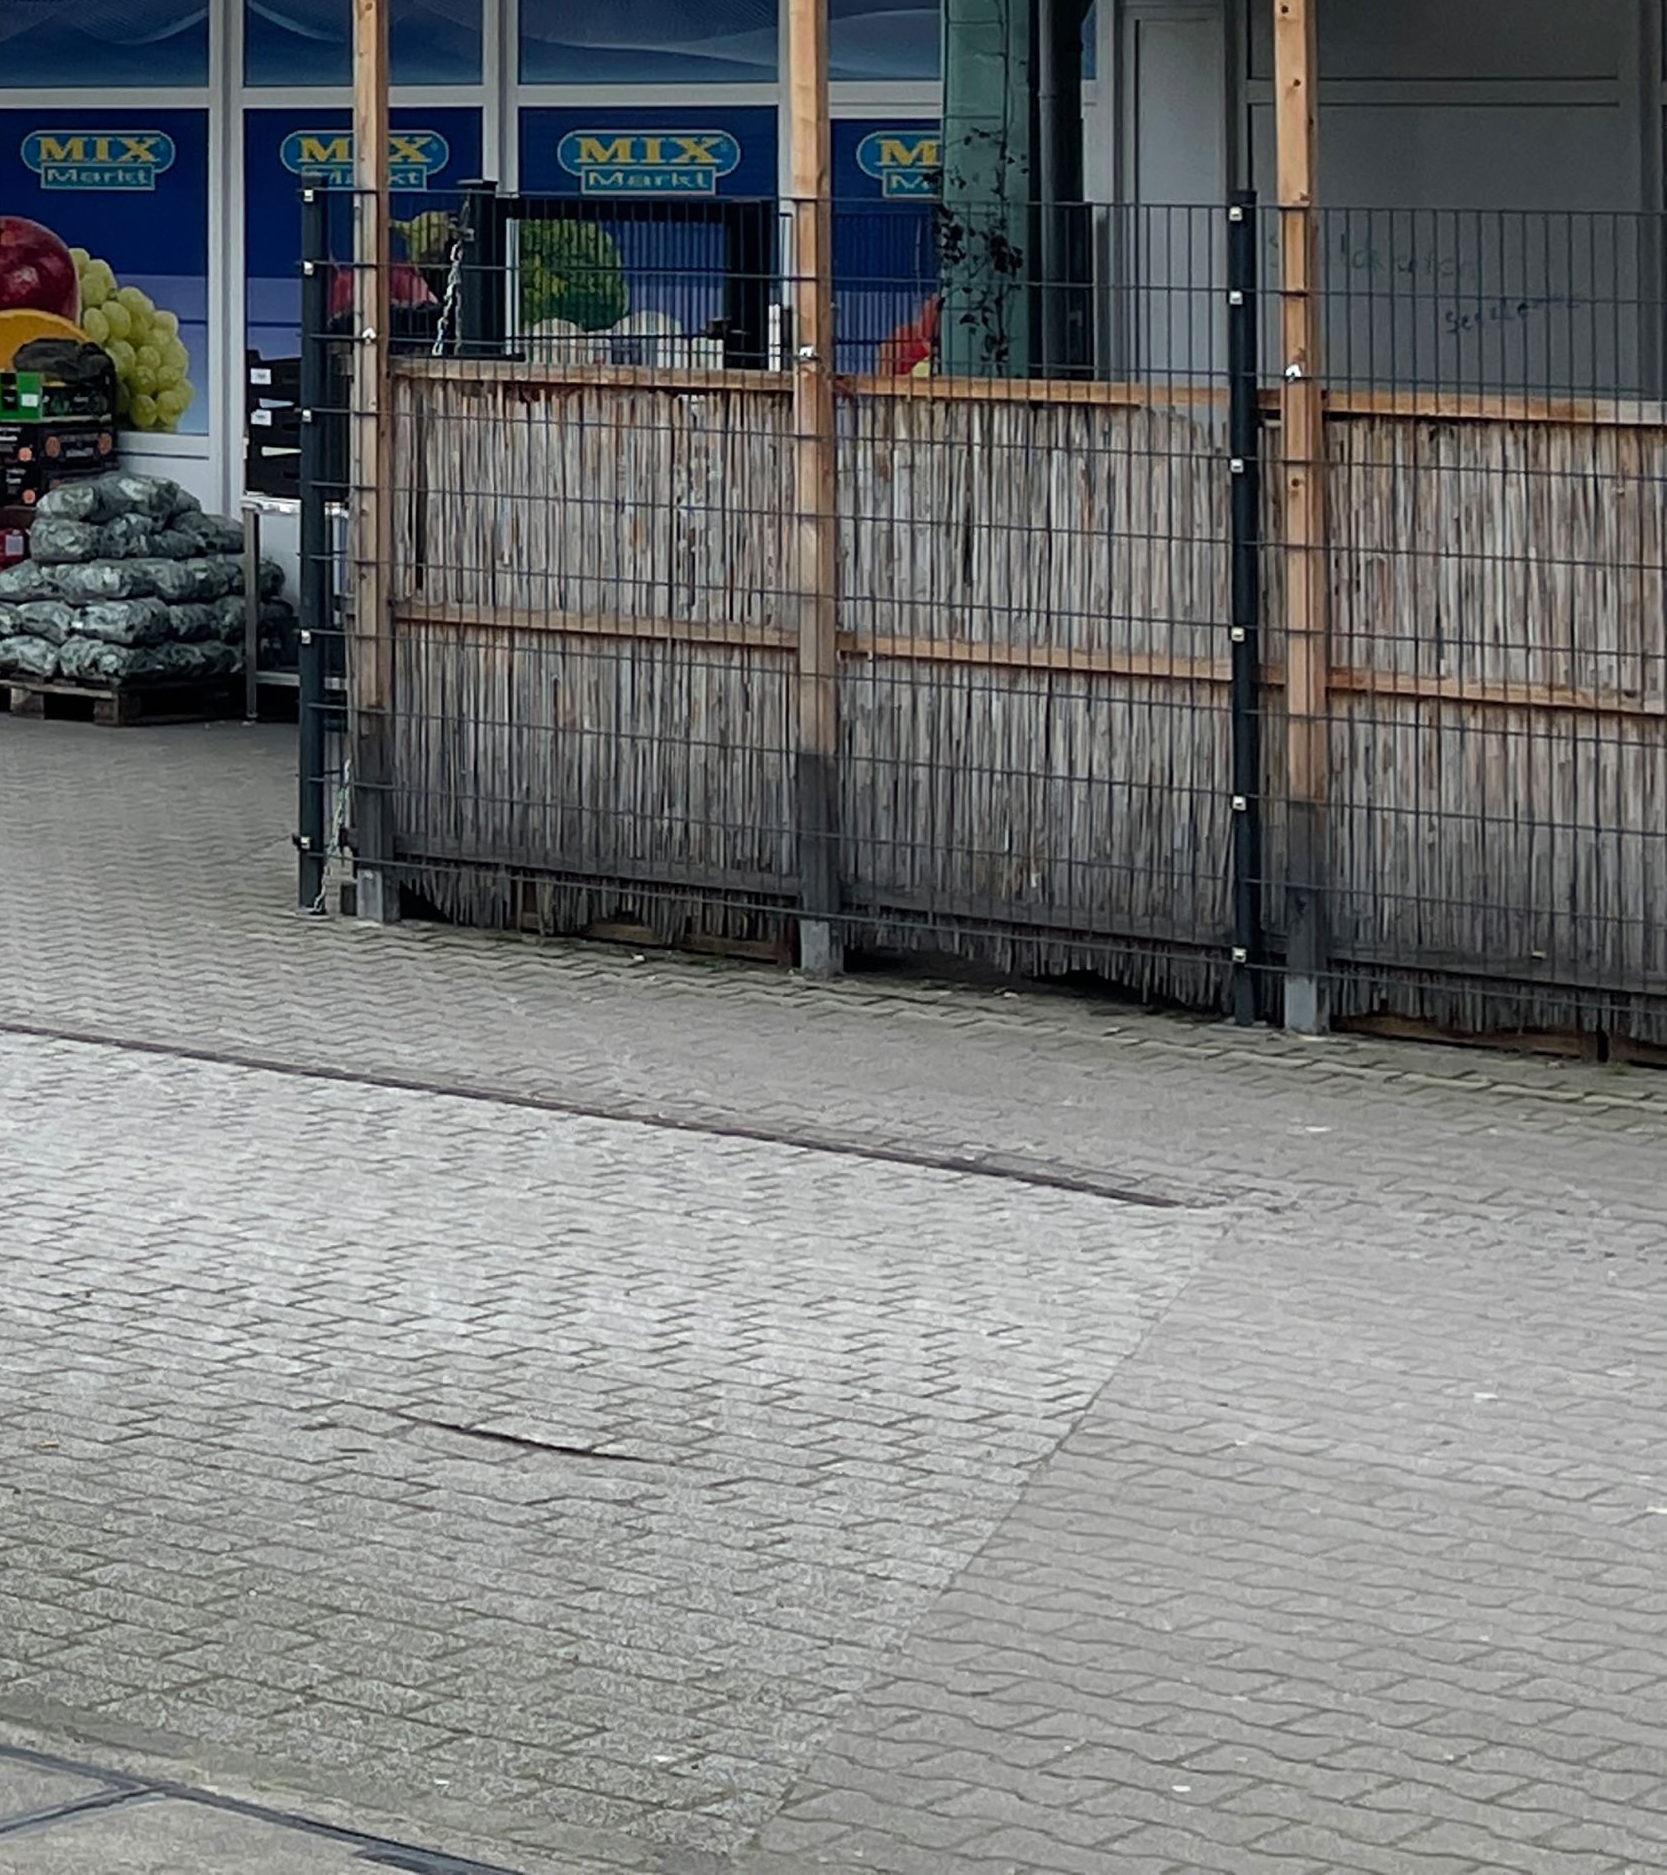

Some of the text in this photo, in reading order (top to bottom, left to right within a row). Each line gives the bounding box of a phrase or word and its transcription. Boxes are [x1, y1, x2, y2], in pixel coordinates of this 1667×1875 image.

[37, 136, 162, 162] MIX
[297, 137, 433, 163] MX
[574, 137, 723, 164] MIX
[587, 170, 710, 189] Markt
